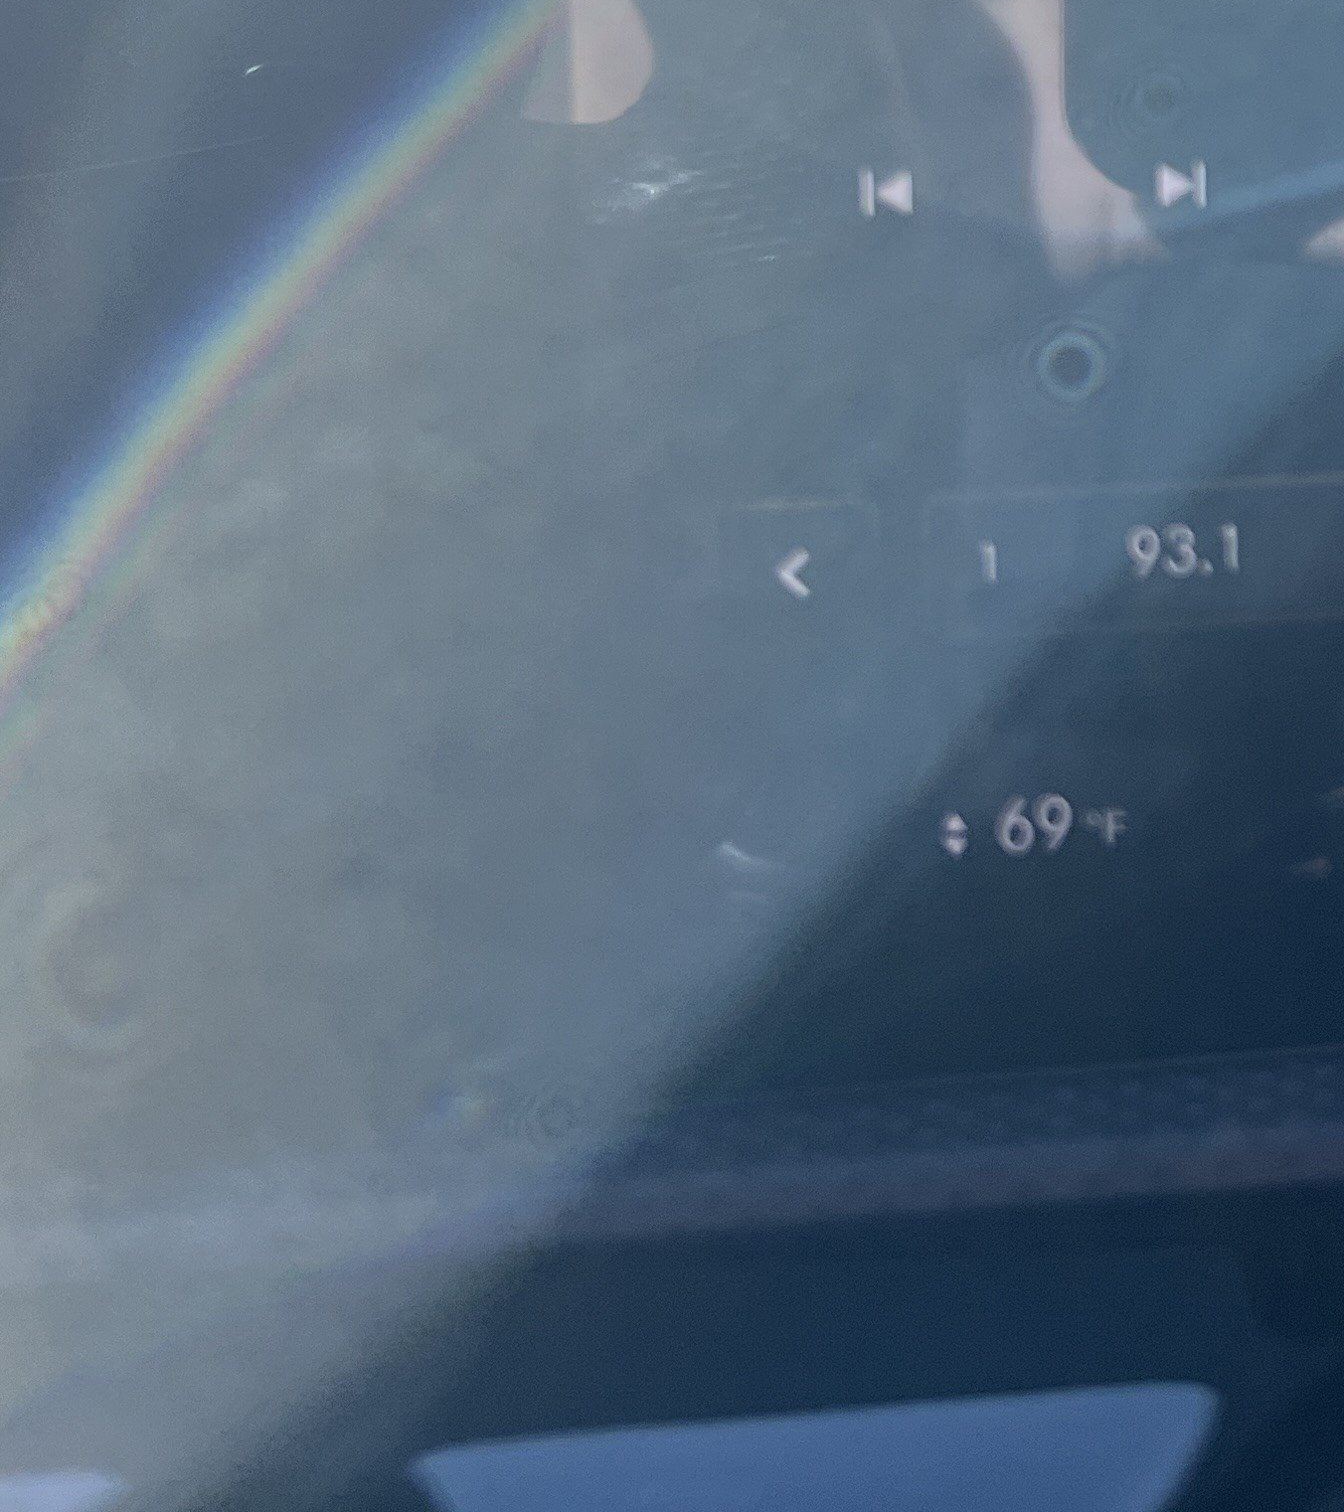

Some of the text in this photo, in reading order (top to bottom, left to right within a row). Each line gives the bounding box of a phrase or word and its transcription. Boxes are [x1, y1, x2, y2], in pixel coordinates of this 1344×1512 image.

[981, 538, 997, 584] 1
[1125, 522, 1241, 579] 93.1
[996, 793, 1074, 854] 69
